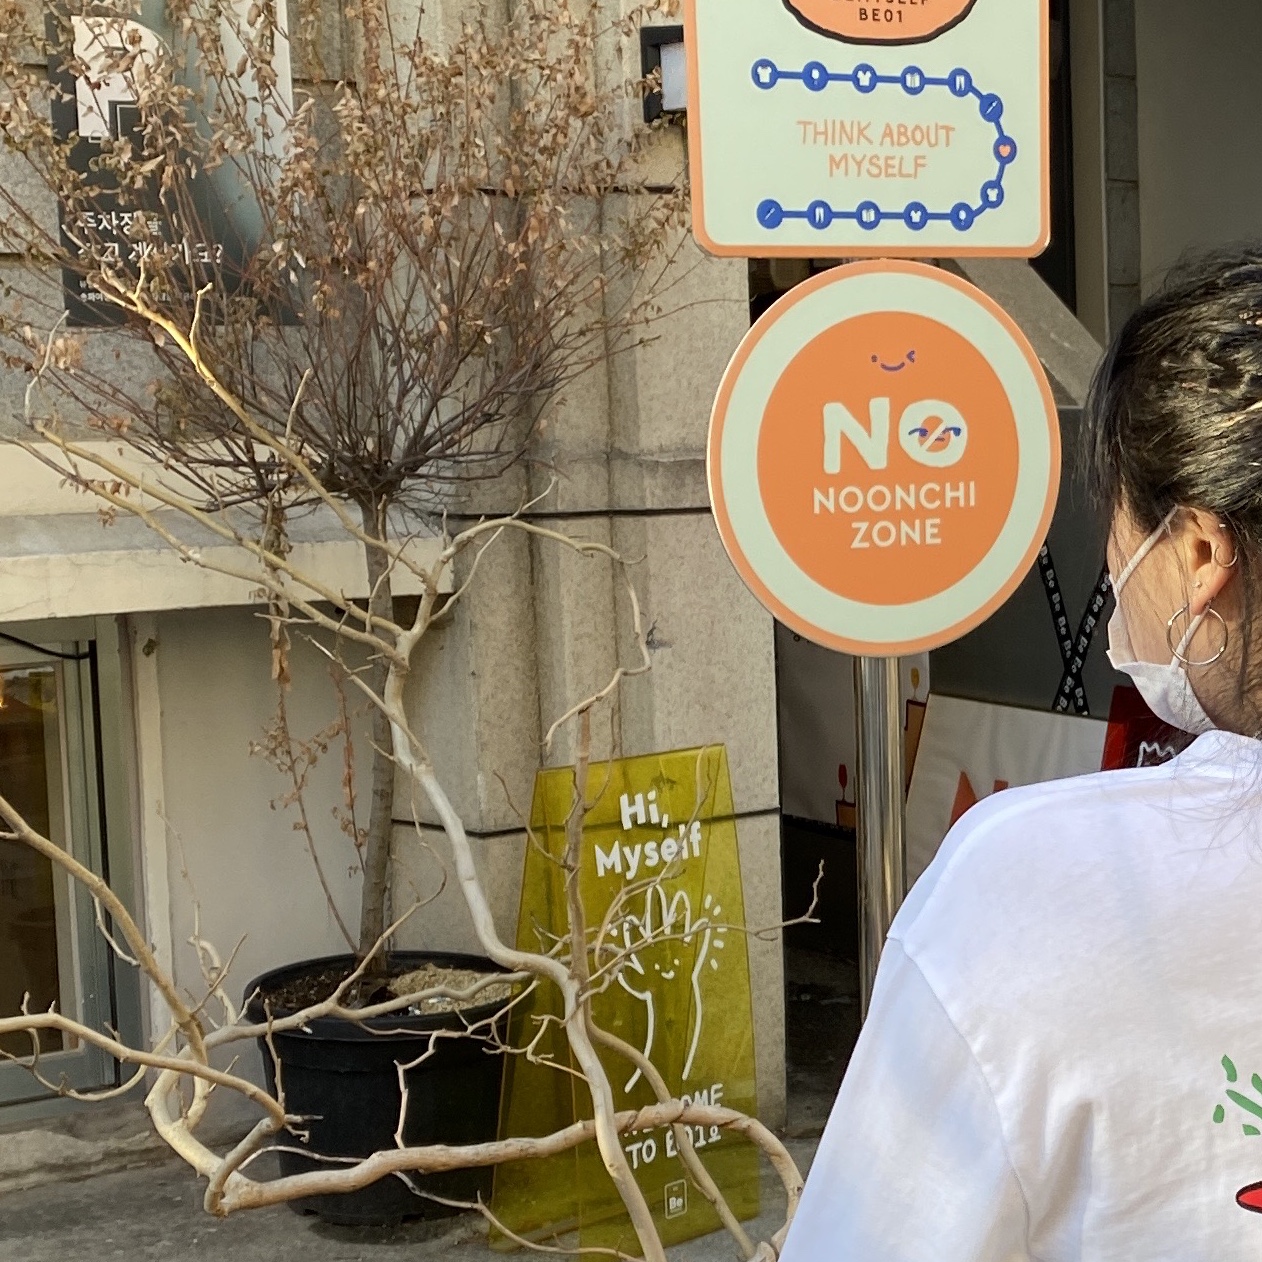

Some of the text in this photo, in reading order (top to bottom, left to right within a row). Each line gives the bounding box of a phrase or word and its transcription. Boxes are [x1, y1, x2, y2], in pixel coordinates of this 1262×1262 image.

[859, 8, 903, 23] BE01
[796, 119, 956, 148] THINK ABOUT
[828, 154, 928, 180] MYSELF
[822, 396, 969, 475] NO
[812, 480, 977, 515] NOONCHI
[850, 517, 942, 550] ZONE
[619, 789, 669, 831] Hi,
[594, 820, 702, 881] Myself
[625, 1138, 657, 1170] TO
